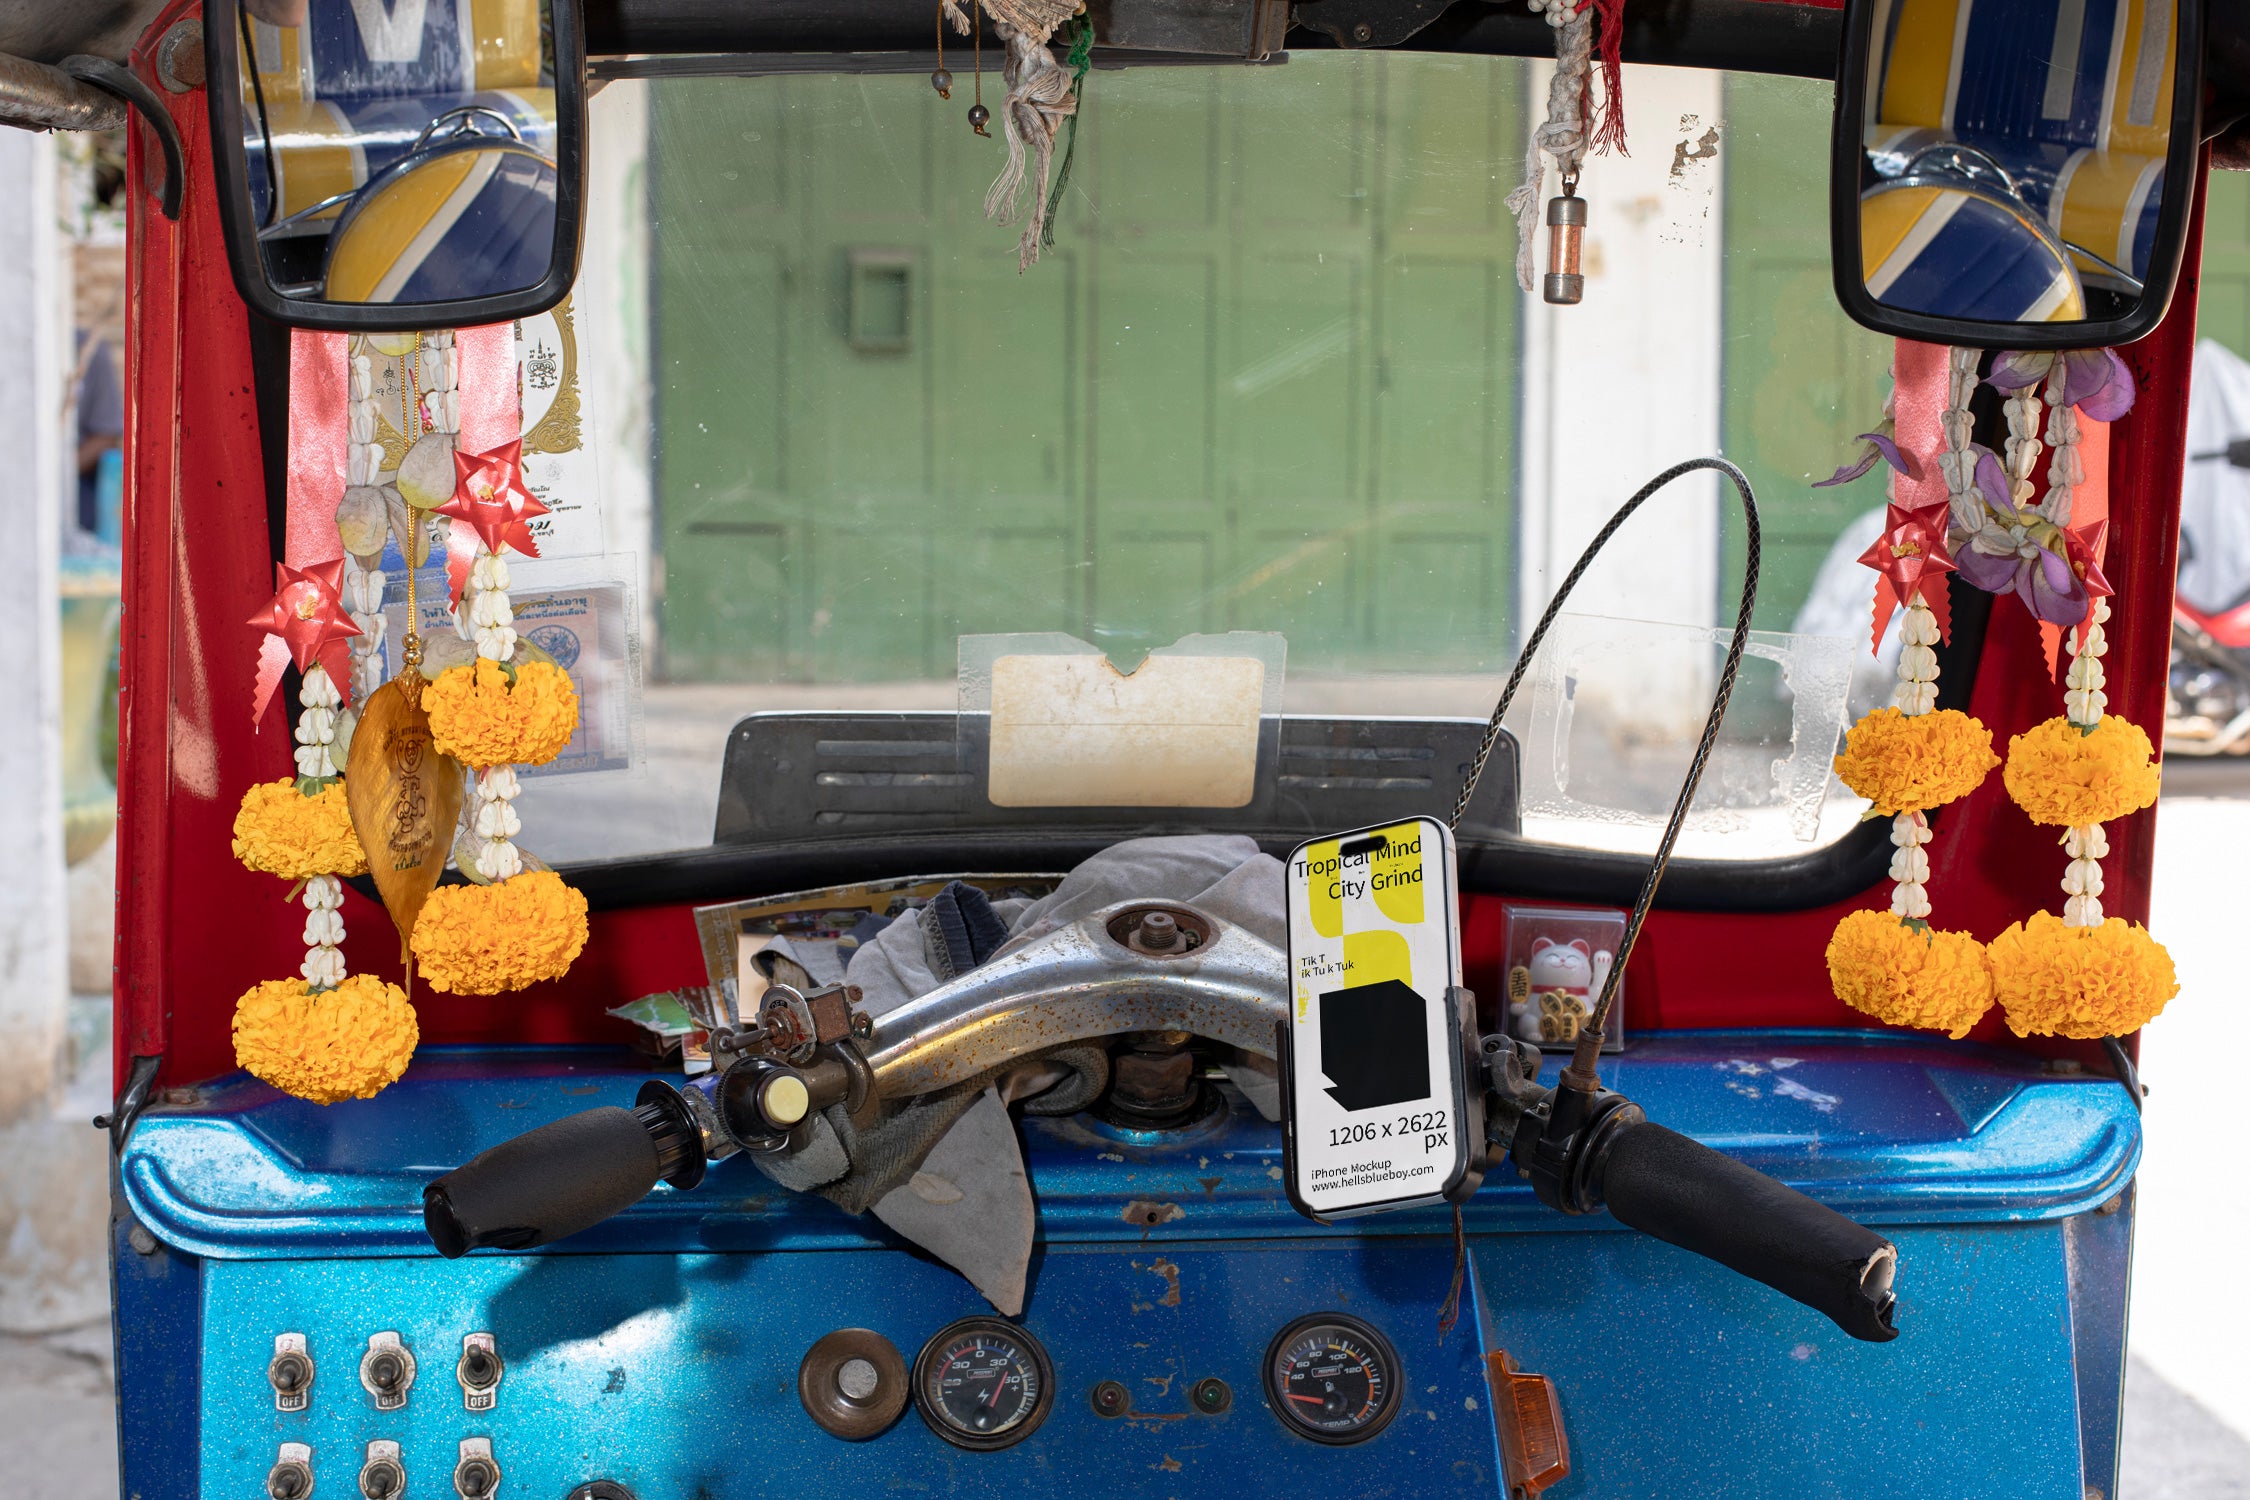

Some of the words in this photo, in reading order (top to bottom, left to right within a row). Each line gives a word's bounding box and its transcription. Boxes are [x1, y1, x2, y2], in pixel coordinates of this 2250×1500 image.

[1294, 850, 1370, 877] Tropical
[1376, 834, 1422, 861] Mind
[1328, 879, 1365, 900] City
[1371, 863, 1423, 890] Grind
[1301, 955, 1317, 967] Tik
[1318, 953, 1326, 964] T
[1335, 959, 1354, 972] Tuk
[1329, 1122, 1377, 1147] 1206
[1381, 1122, 1393, 1138] x
[1397, 1110, 1447, 1136] 2622
[1424, 1131, 1449, 1154] px
[1311, 1167, 1348, 1181] iPhone
[1350, 1159, 1392, 1174] Mockup
[1311, 1164, 1434, 1193] www.hellsblueboy.com
[1309, 1350, 1323, 1358] 80
[1328, 1353, 1347, 1361] 100
[951, 1361, 970, 1369] 30
[989, 1358, 1008, 1366] 30
[1344, 1366, 1362, 1374] 120
[1291, 1373, 1305, 1381] 40
[282, 1395, 299, 1407] OFF
[381, 1394, 400, 1406] OFF
[470, 1395, 489, 1407] OFF
